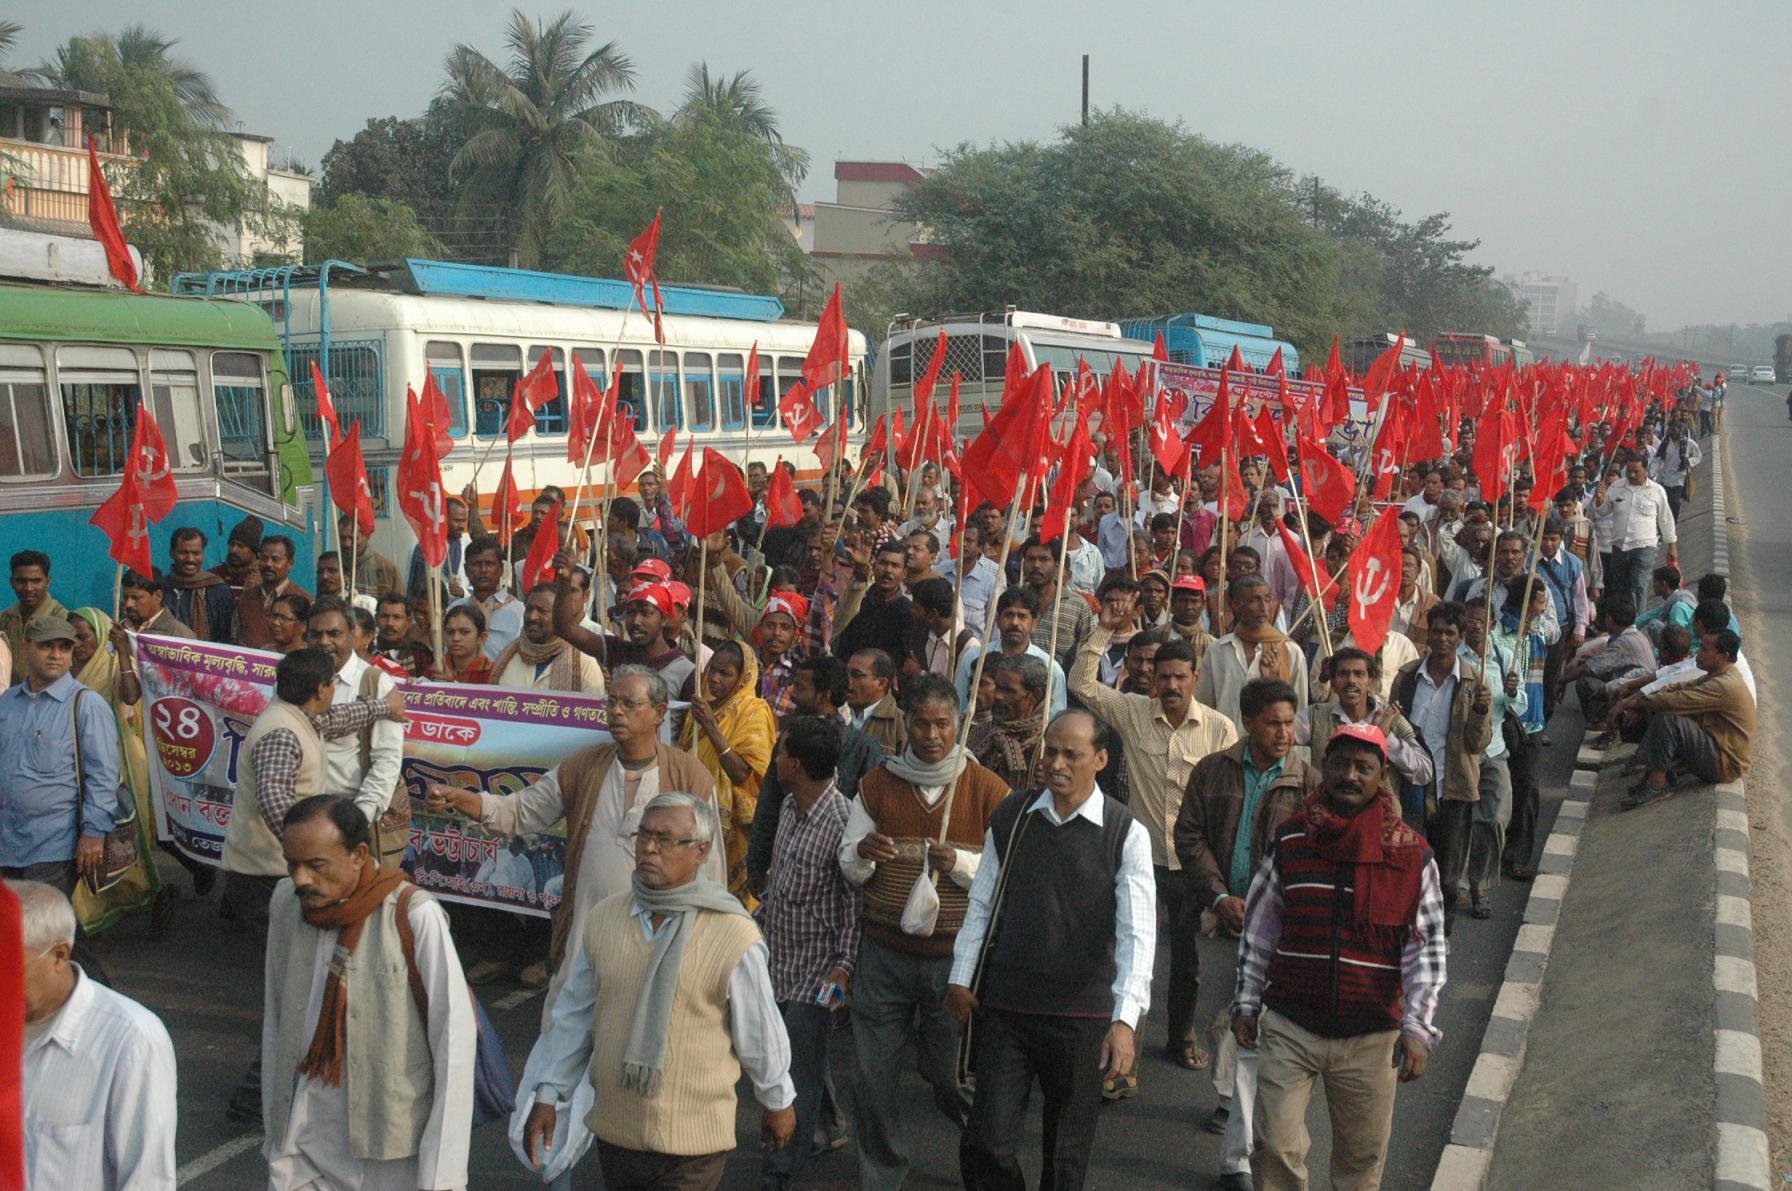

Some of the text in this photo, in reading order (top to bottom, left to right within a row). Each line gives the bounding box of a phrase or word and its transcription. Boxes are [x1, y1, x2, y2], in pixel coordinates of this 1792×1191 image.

[146, 643, 201, 665] অস্বাভাবিক
[203, 654, 248, 676] মূল্যবৃদ্ধি,
[424, 690, 469, 710] প্রতিবাদে
[469, 697, 491, 712] এবং
[492, 696, 518, 715] শান্তি,
[522, 698, 560, 718] সম্প্রীতি
[561, 706, 572, 719] ও
[155, 703, 201, 740] ২৪
[420, 722, 478, 741] ডাকে
[428, 826, 502, 865] ভট্টাচার্য
